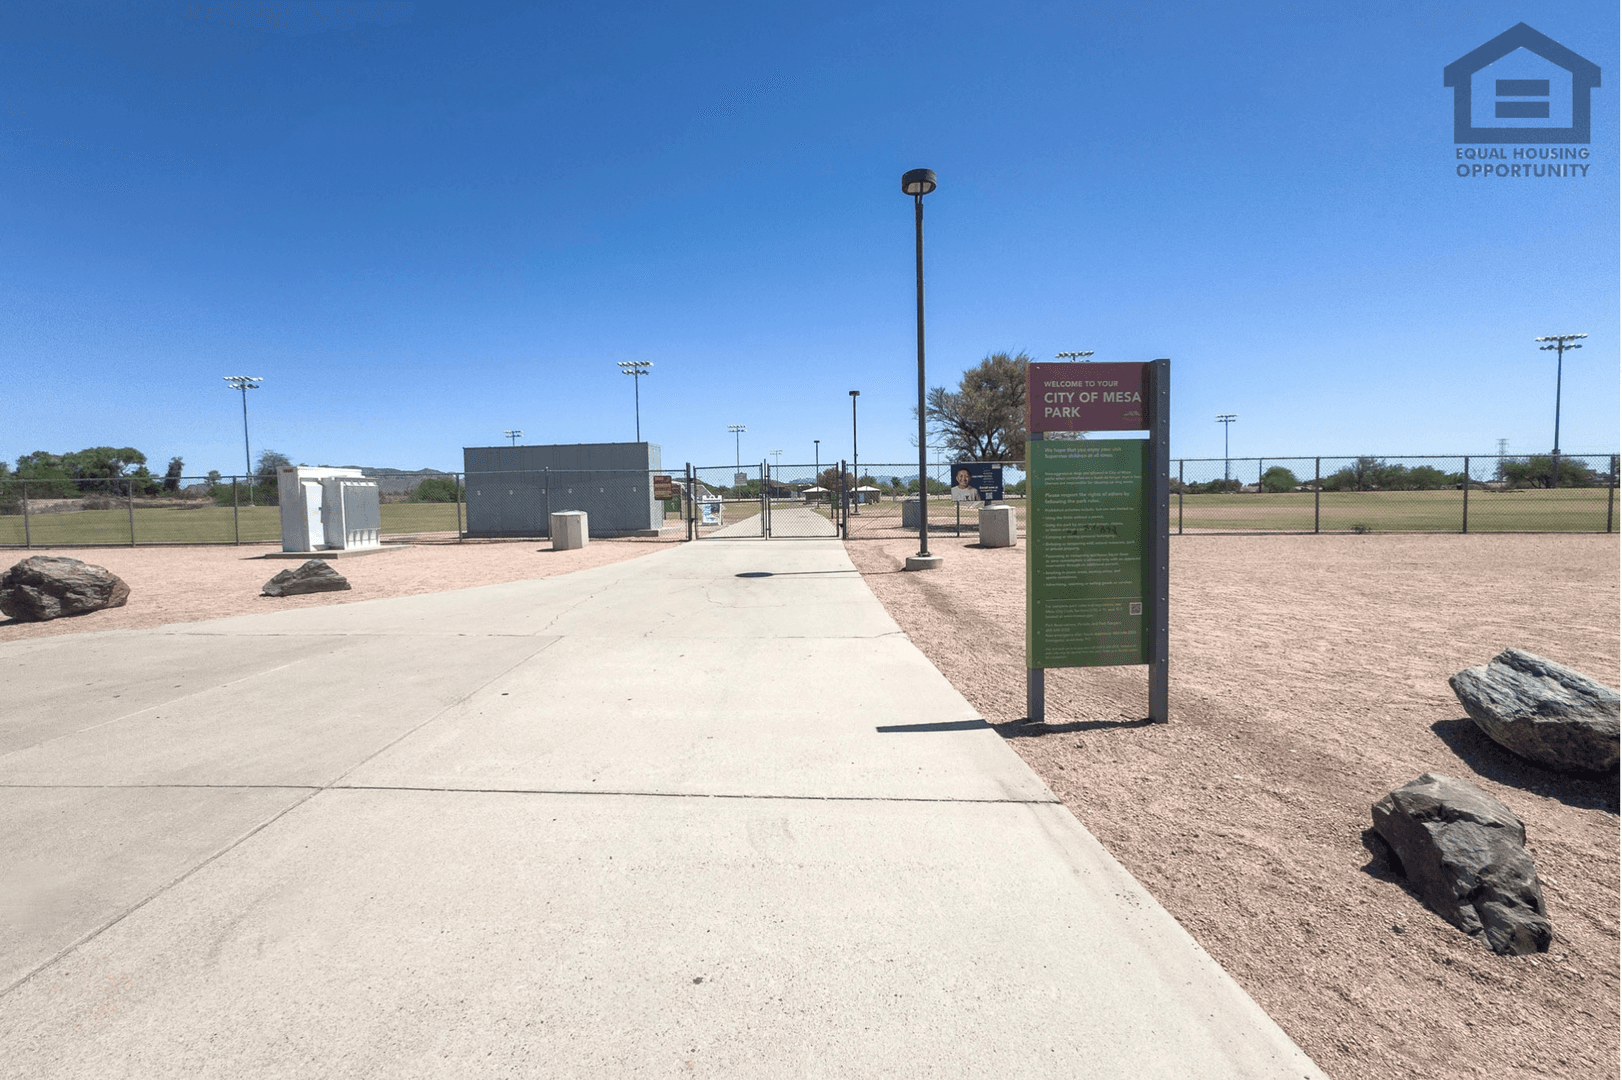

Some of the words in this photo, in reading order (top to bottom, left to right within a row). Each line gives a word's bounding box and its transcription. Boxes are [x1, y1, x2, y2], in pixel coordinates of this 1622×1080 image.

[1044, 392, 1075, 403] CITY
[1079, 392, 1098, 403] OF
[1103, 392, 1141, 403] MESA
[1044, 406, 1081, 418] PARK
